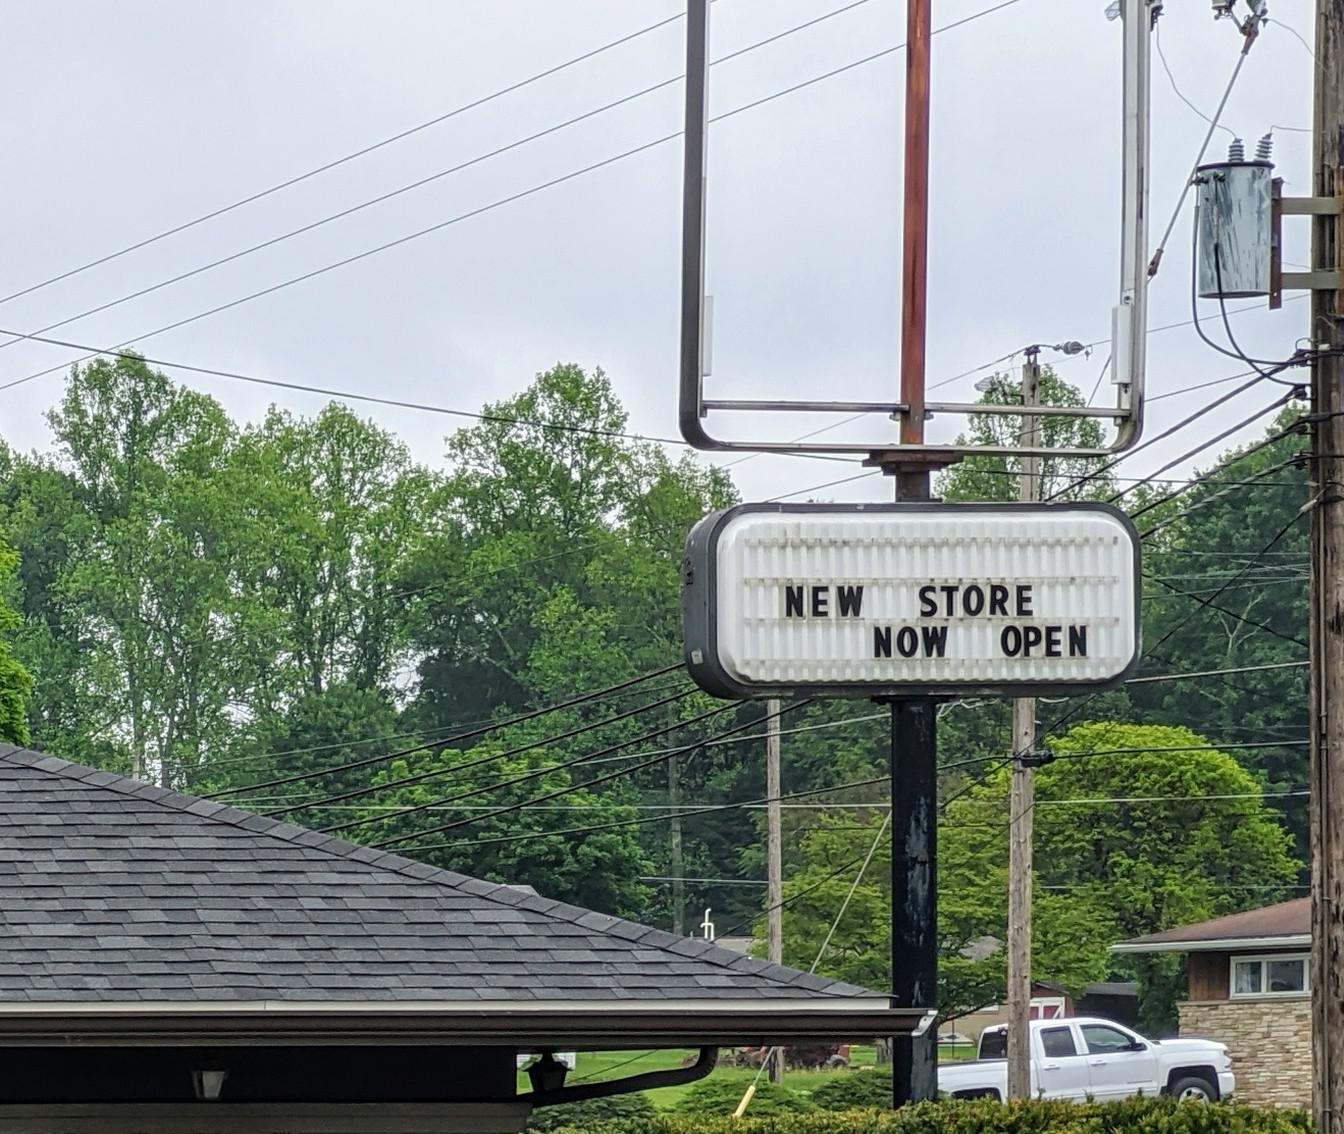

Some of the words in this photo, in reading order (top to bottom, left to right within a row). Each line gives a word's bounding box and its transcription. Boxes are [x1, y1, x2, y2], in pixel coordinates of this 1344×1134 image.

[784, 585, 865, 619] NEW
[918, 584, 1034, 618] STORE
[872, 625, 949, 659] NOW
[999, 625, 1088, 658] OPEN
